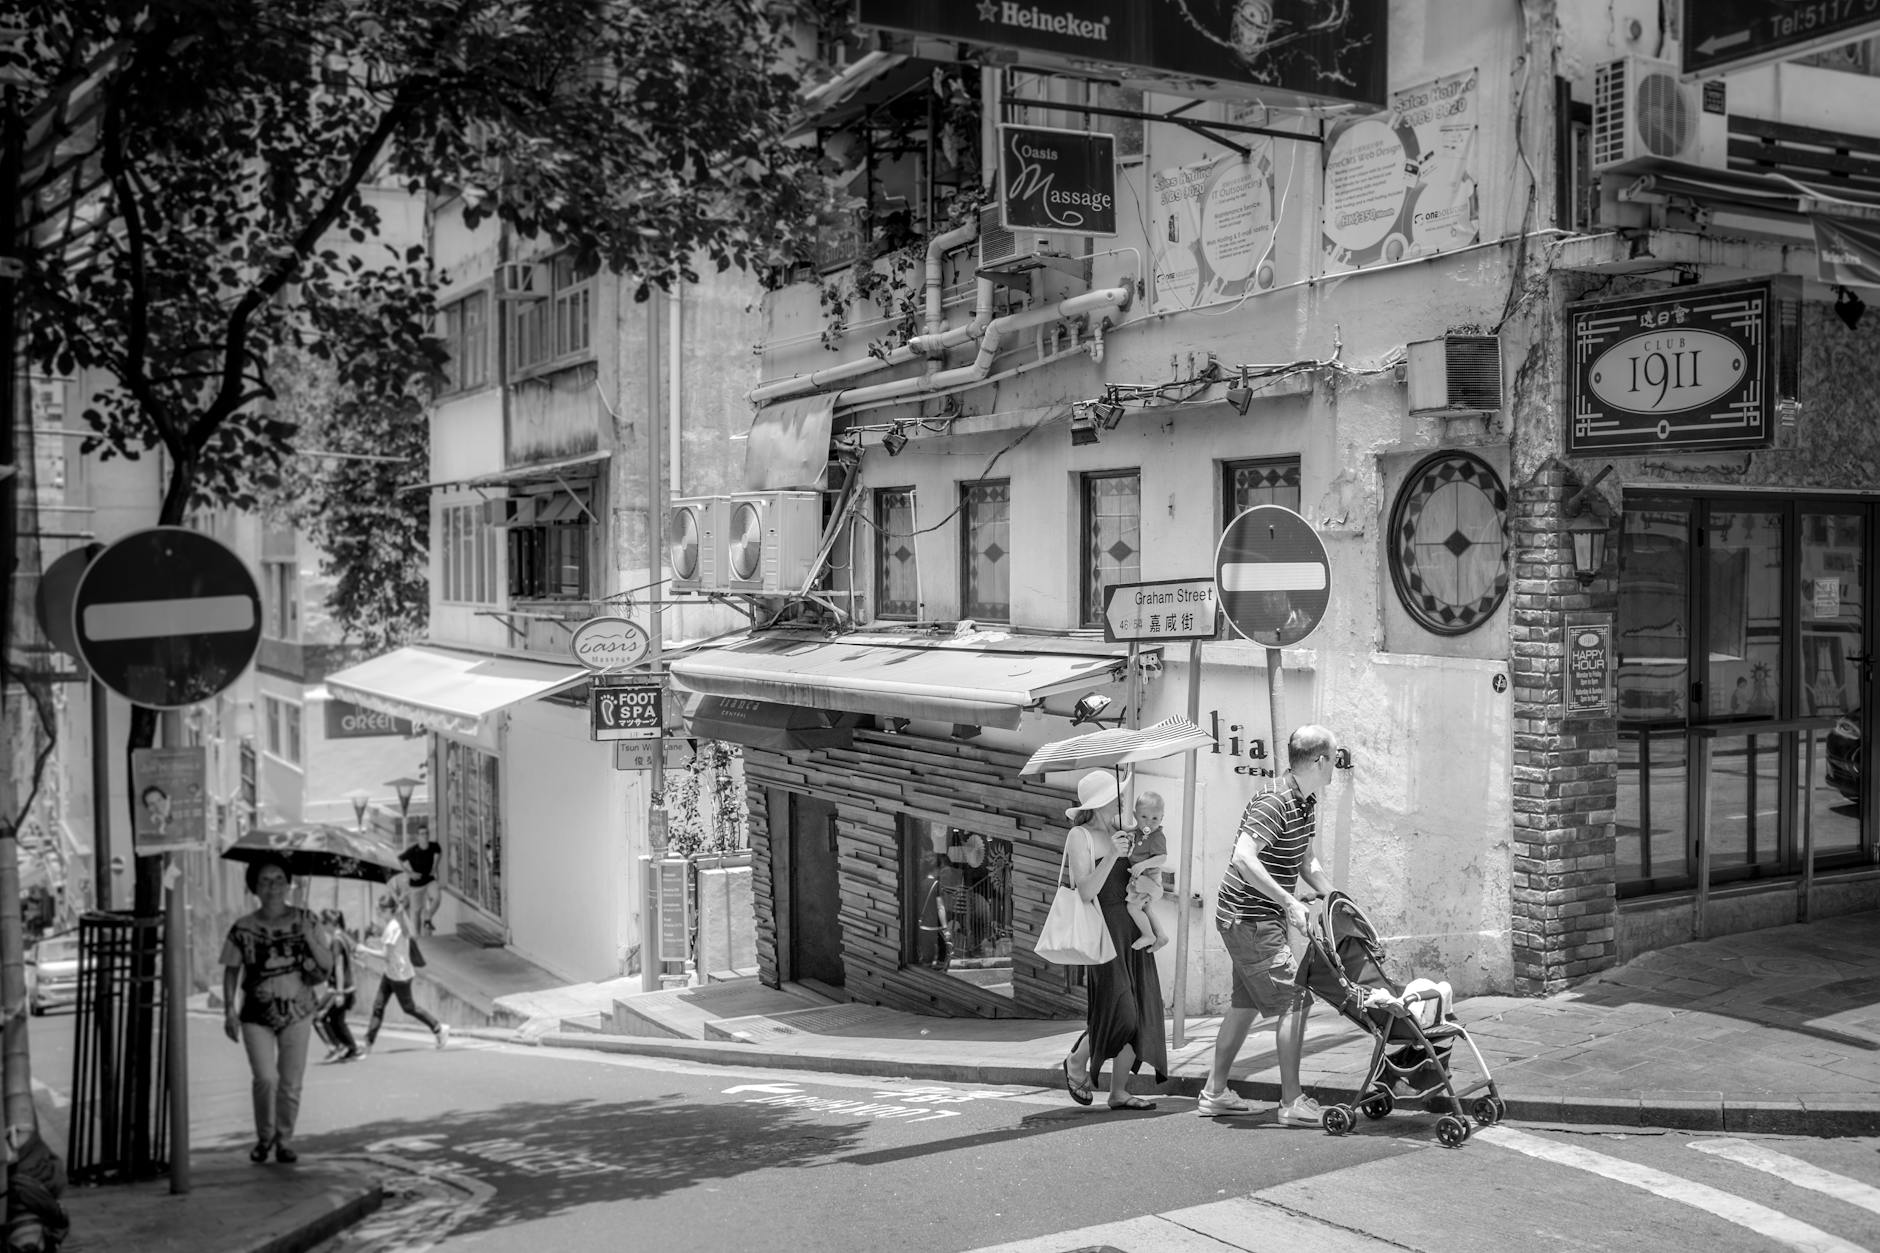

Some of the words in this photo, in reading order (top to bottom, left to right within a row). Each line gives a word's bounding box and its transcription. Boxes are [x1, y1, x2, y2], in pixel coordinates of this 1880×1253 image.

[1001, 1, 1108, 40] Heineken
[1393, 93, 1428, 112] Sales
[1021, 144, 1058, 160] Oasis
[1009, 134, 1111, 226] Massage
[1219, 179, 1263, 198] Outsourcing
[1644, 337, 1686, 352] CLUB
[1627, 351, 1703, 408] 1911
[1135, 591, 1174, 606] Graham
[1177, 587, 1213, 603] Street
[1149, 612, 1194, 633] 嘉咸街
[1573, 649, 1604, 660] HAPPY
[1572, 659, 1605, 671] HOUR
[618, 692, 657, 706] FOOT
[620, 705, 656, 719] SPA
[621, 743, 640, 751] Tsun
[828, 1102, 962, 1123] LOOK
